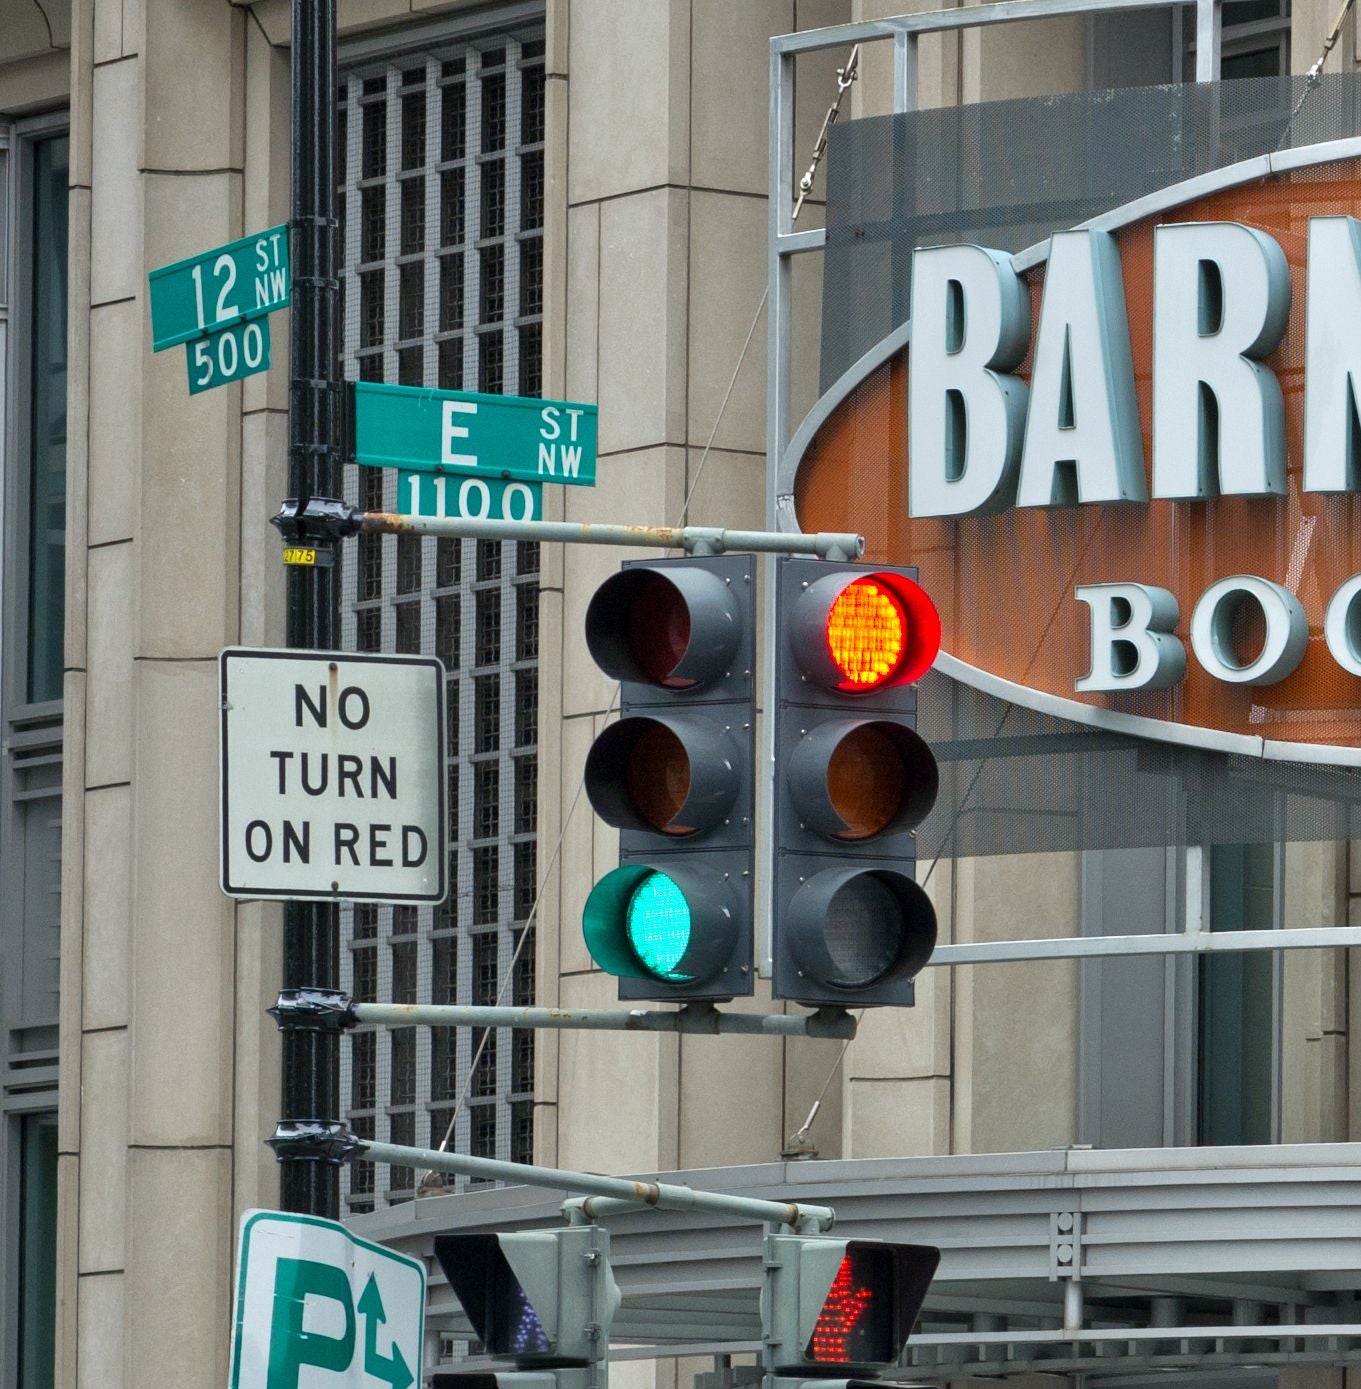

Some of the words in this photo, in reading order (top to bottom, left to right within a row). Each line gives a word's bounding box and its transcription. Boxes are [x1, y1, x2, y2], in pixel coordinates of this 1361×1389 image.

[192, 254, 239, 329] 12
[256, 234, 280, 272] ST
[255, 267, 286, 309] NW
[195, 323, 263, 386] 500
[441, 400, 478, 466] E
[539, 406, 584, 442] ST
[538, 442, 583, 478] NW
[408, 474, 535, 522] 1100
[294, 684, 371, 731] NO
[269, 750, 398, 799] TURN
[245, 818, 312, 866] ON
[333, 821, 428, 869] RED
